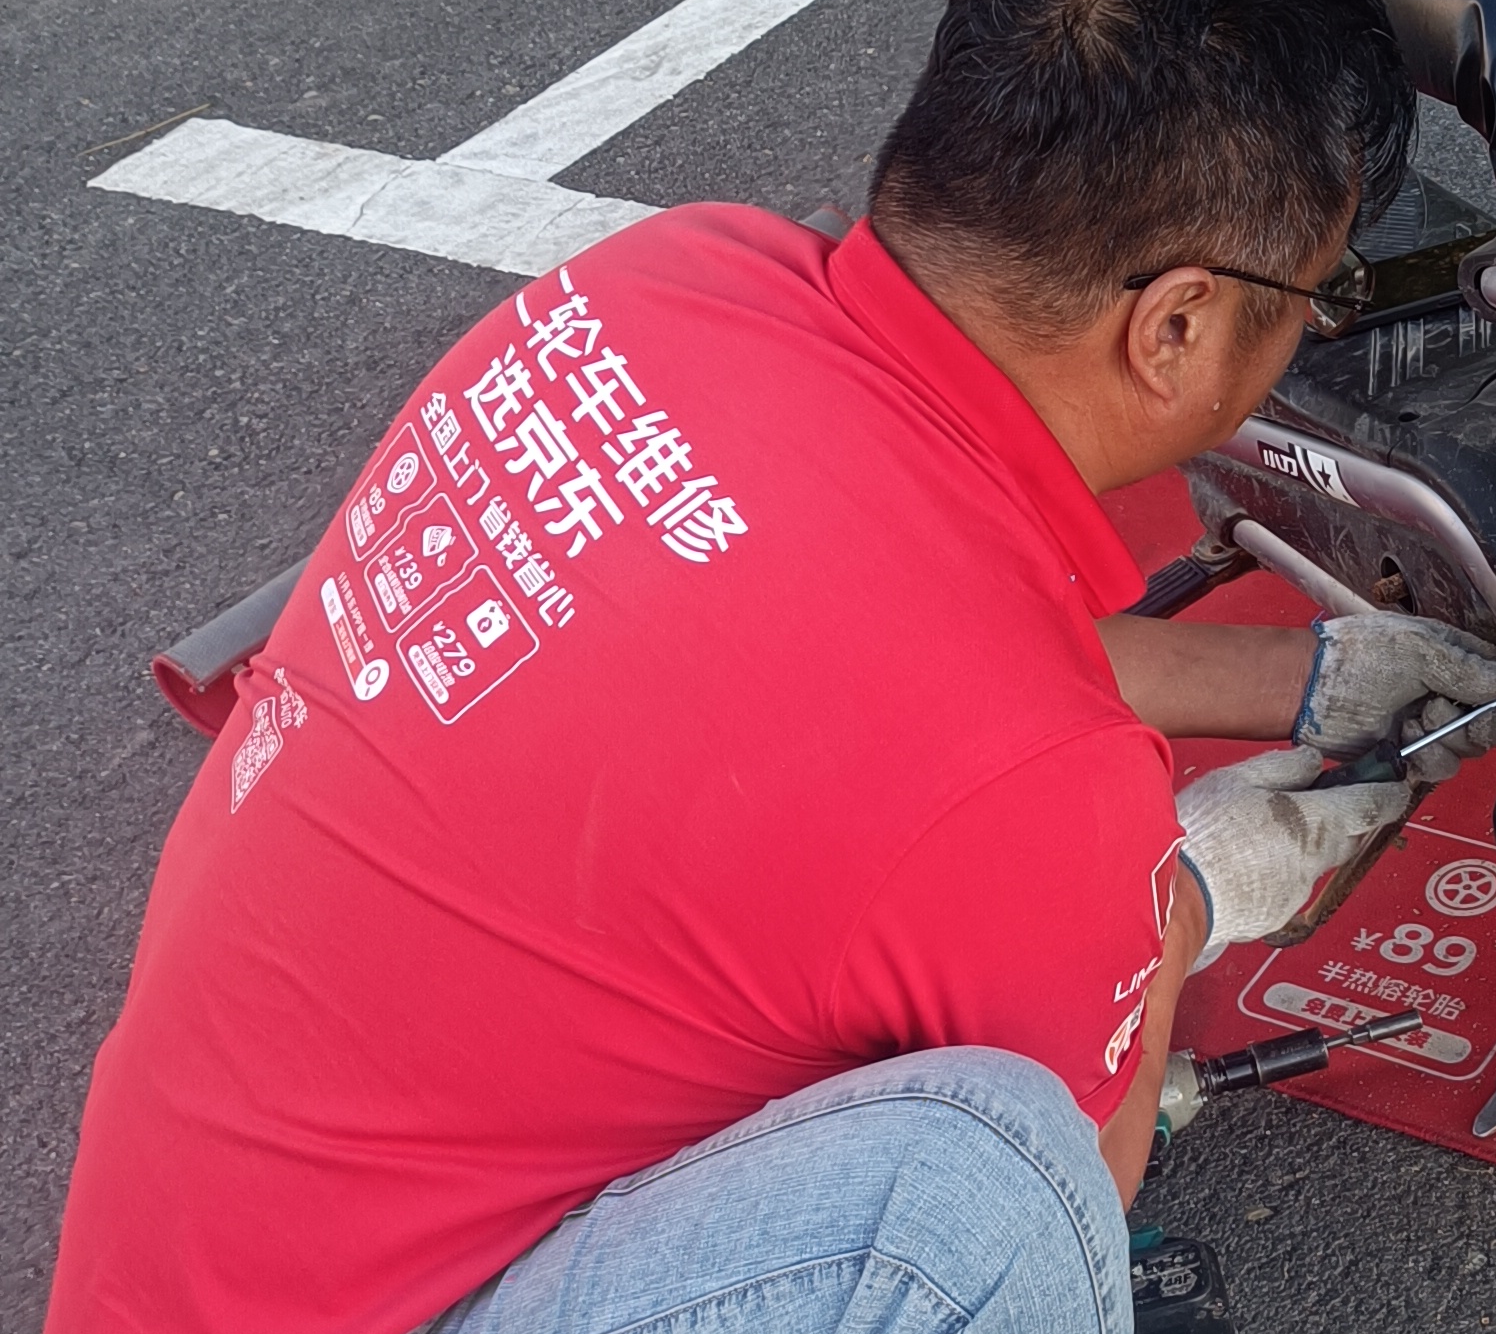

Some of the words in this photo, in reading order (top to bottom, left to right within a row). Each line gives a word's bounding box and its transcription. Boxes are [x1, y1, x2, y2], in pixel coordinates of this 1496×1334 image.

[516, 265, 749, 563] 二轮车维修
[463, 343, 625, 558] 选京东
[420, 391, 492, 504] 全国上门
[480, 495, 577, 629] 省钱省心
[394, 545, 423, 590] ¥139
[432, 620, 476, 677] ¥279
[1350, 923, 1478, 977] ¥89
[1317, 960, 1467, 1020] 半热熔轮胎
